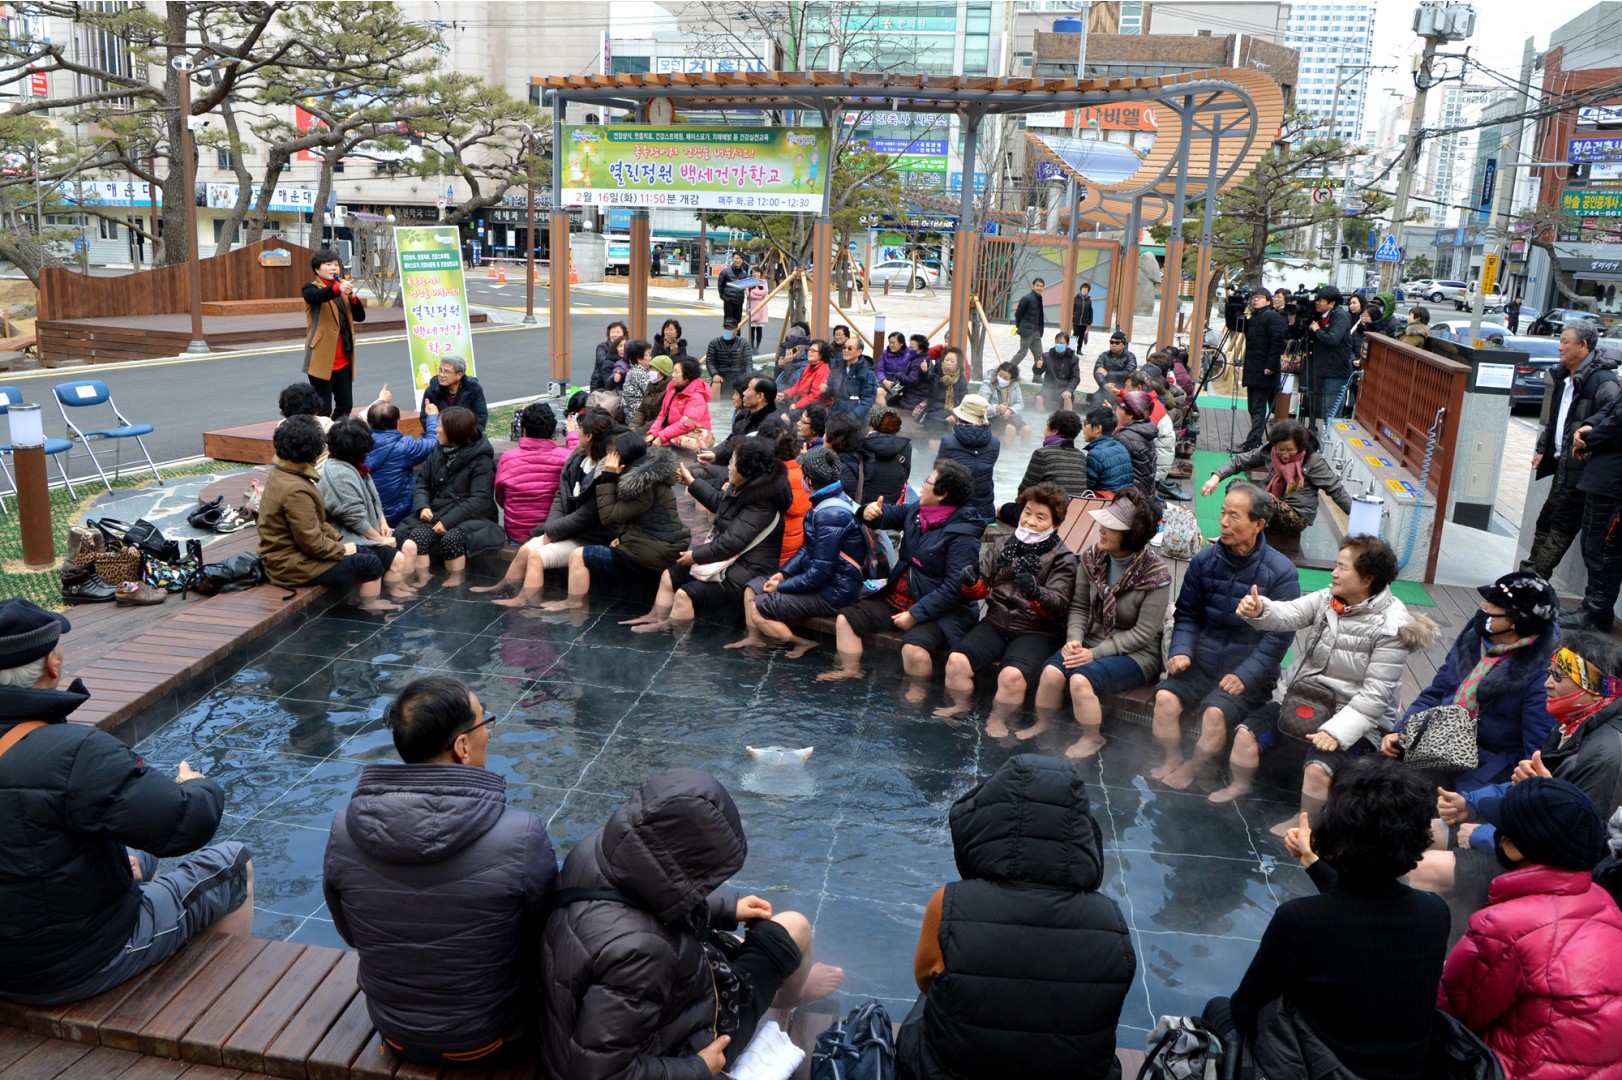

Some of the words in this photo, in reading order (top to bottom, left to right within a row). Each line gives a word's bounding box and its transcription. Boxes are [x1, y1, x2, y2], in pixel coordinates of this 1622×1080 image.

[876, 113, 911, 126] 건축사
[914, 113, 947, 126] 사무소
[683, 145, 711, 161] 건강을
[609, 160, 673, 186] 열린정원
[680, 163, 782, 187] 백세건강학교
[278, 189, 312, 204] 해운대
[575, 191, 593, 203] 2월
[598, 192, 638, 204] 16일(화)
[640, 193, 677, 205] 11:50분
[679, 194, 700, 206] 개강
[718, 195, 734, 206] 매주
[1563, 194, 1581, 209] 한솔
[1582, 195, 1619, 210] 공인중개사
[411, 304, 460, 320] 열린정원
[413, 323, 463, 338] 백세건강
[427, 342, 454, 355] 학교
